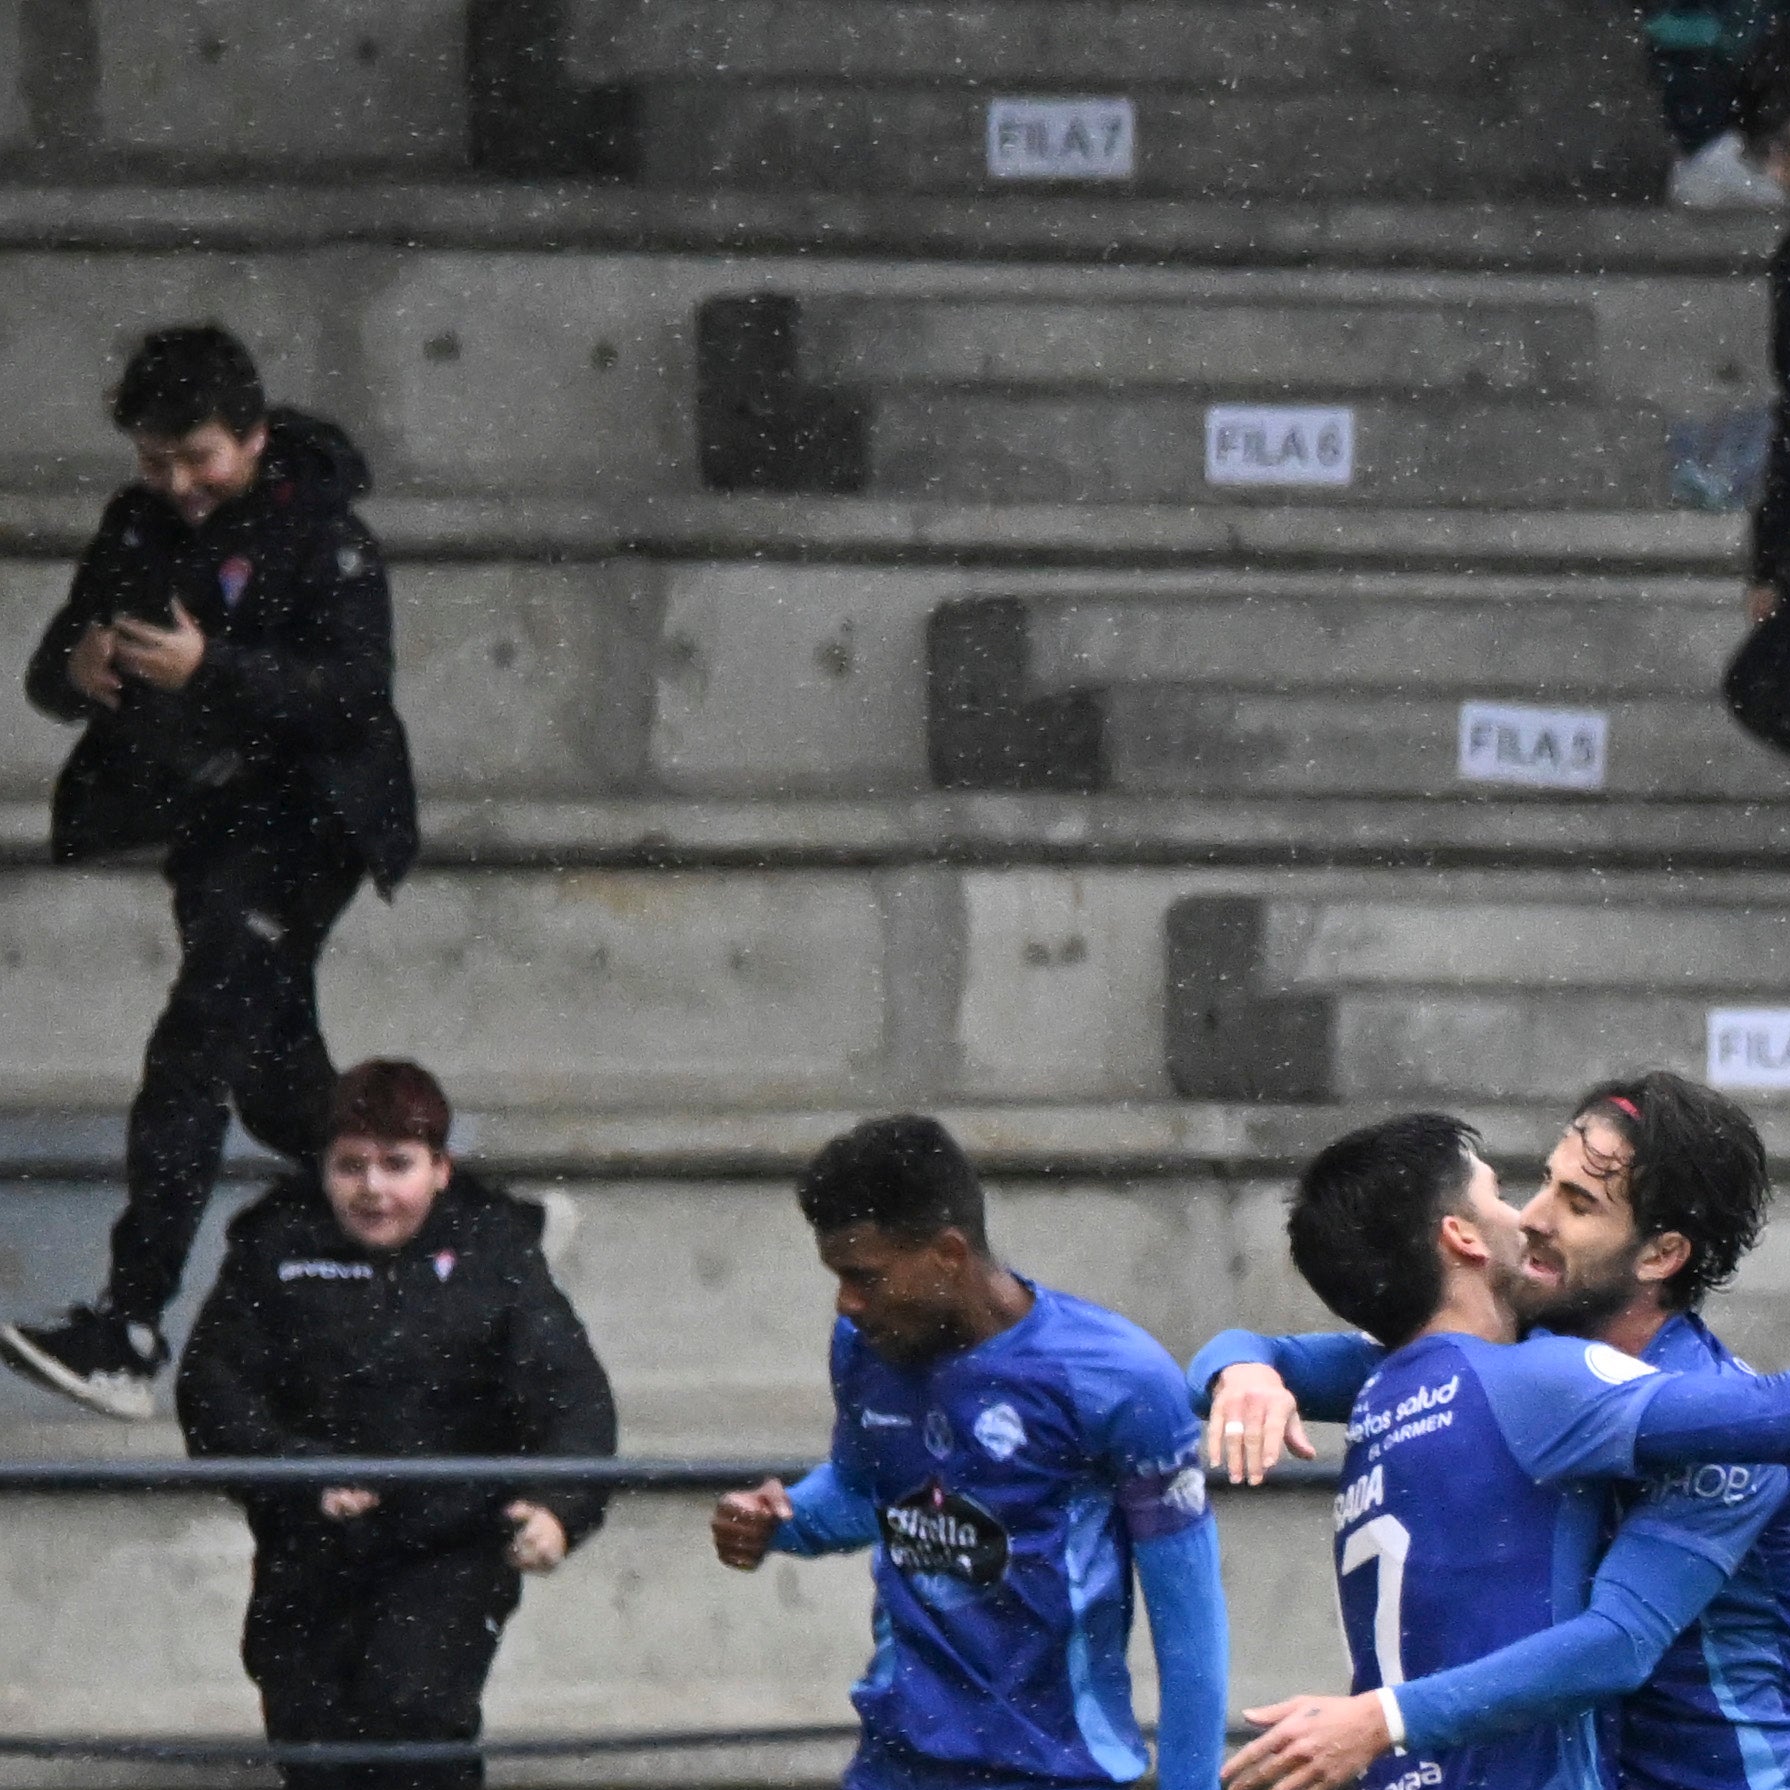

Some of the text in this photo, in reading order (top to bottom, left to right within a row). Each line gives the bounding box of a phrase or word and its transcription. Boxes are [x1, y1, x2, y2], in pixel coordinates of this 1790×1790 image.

[1000, 117, 1122, 158] FILA 7
[1216, 423, 1340, 466] FILA 6
[1469, 723, 1561, 768] FILA
[1396, 1375, 1459, 1421] salud
[1342, 1513, 1411, 1725] 7
